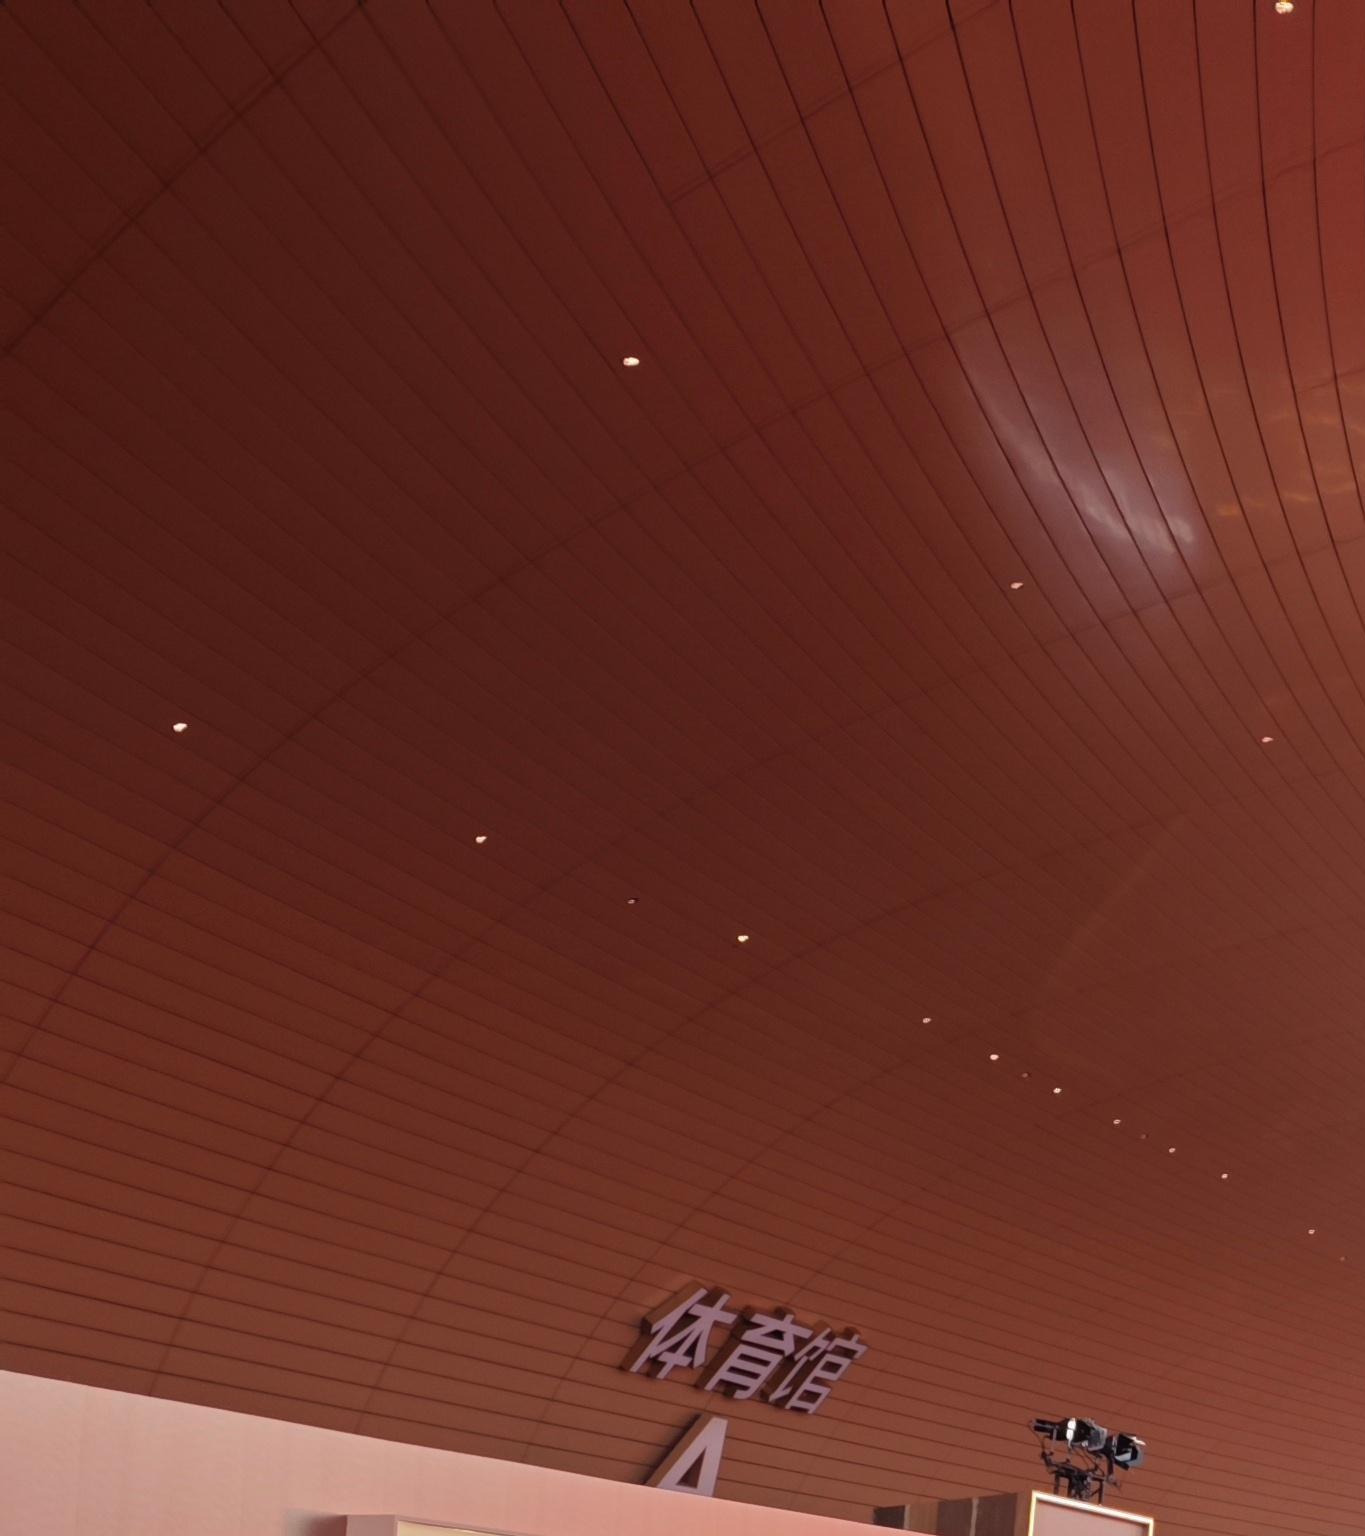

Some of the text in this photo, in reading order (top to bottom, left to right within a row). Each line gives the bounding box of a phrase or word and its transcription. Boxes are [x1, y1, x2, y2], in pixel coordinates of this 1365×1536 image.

[629, 1287, 869, 1415] 体育馆
[655, 1416, 729, 1497] A
